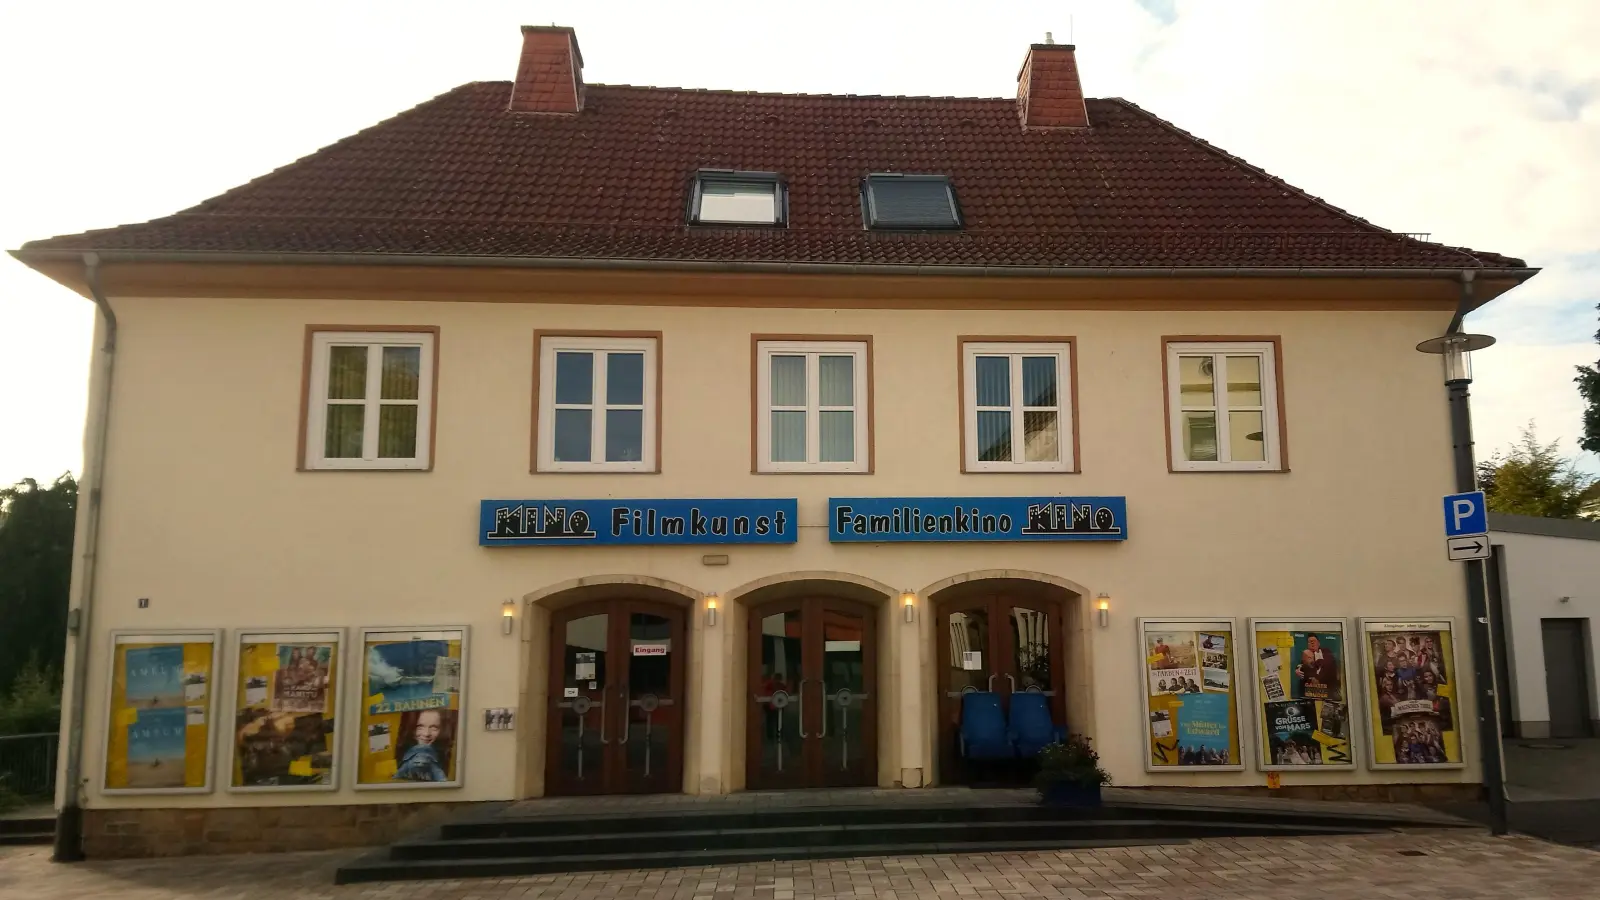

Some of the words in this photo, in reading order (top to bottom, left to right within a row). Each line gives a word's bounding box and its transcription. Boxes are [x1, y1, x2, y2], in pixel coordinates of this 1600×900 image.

[487, 504, 597, 540] KINO
[611, 507, 786, 536] Filmkunst
[836, 505, 1013, 535] Familienkino
[1021, 501, 1121, 535] KINO
[1453, 499, 1475, 531] P
[635, 647, 665, 655] Eingang
[376, 702, 391, 714] 22
[394, 697, 446, 712] BAHNEN
[1286, 722, 1312, 732] MARS
